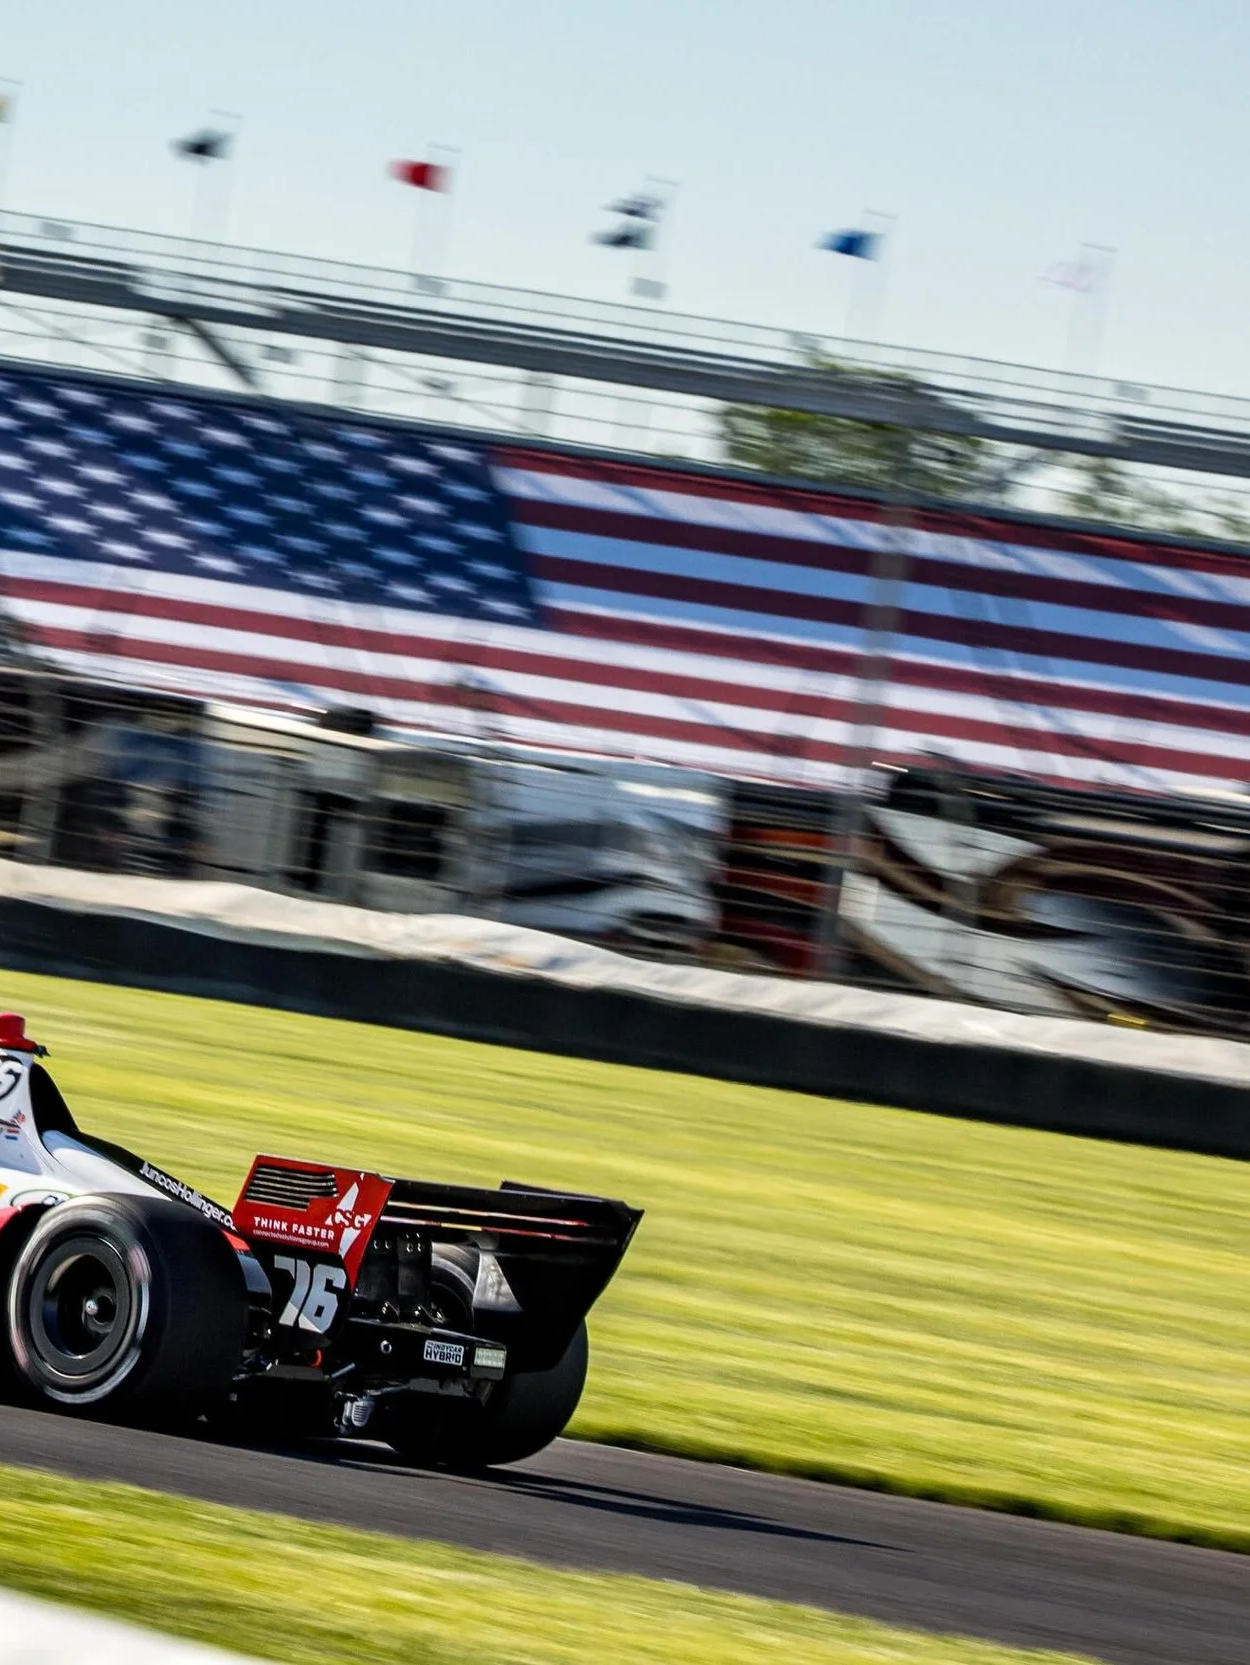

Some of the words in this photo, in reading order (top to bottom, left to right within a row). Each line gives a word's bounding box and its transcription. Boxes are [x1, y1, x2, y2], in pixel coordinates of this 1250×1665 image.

[253, 1216, 288, 1231] THINK
[292, 1223, 335, 1240] FASTER
[274, 1254, 347, 1335] 76
[425, 1347, 462, 1364] HYBRID
